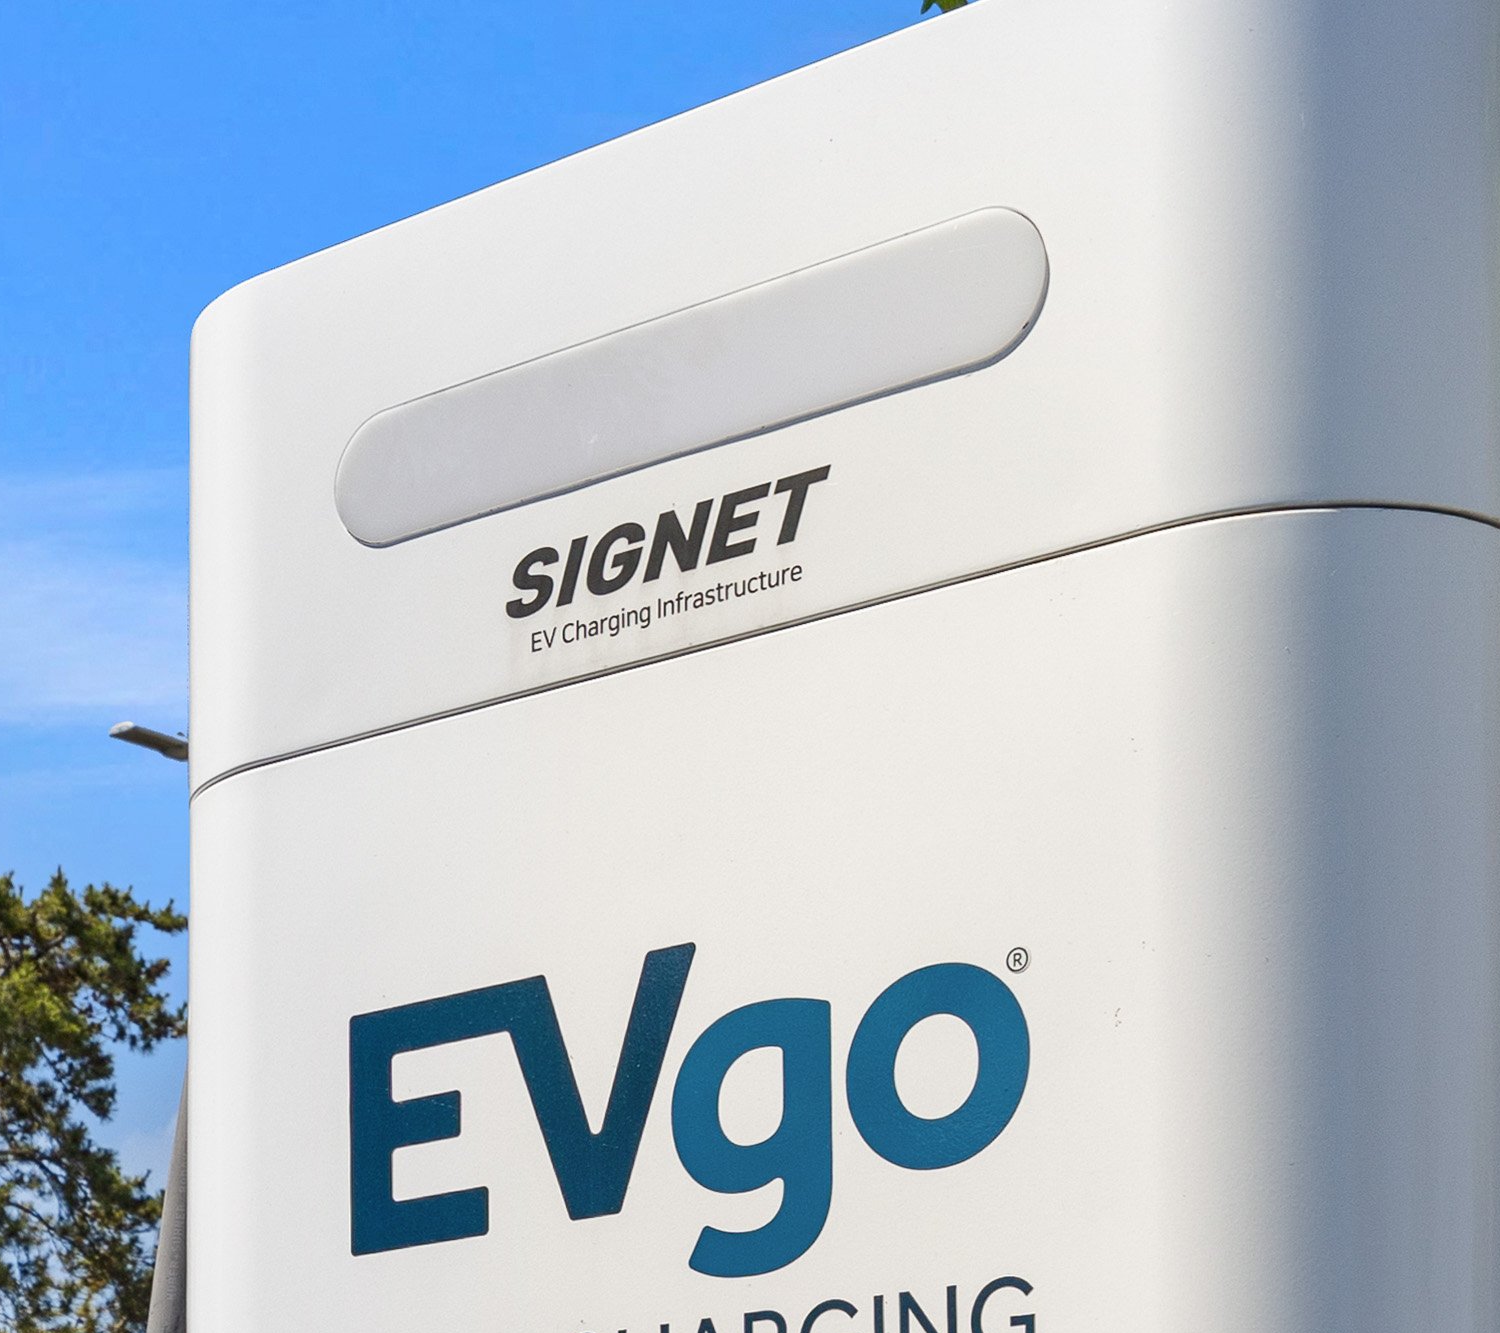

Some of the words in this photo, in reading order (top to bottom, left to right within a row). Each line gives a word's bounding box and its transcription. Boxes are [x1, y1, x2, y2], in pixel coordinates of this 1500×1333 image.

[506, 464, 831, 619] SIGNET
[531, 626, 556, 653] EV
[562, 604, 650, 644] Charging
[657, 564, 802, 619] Infrastructure
